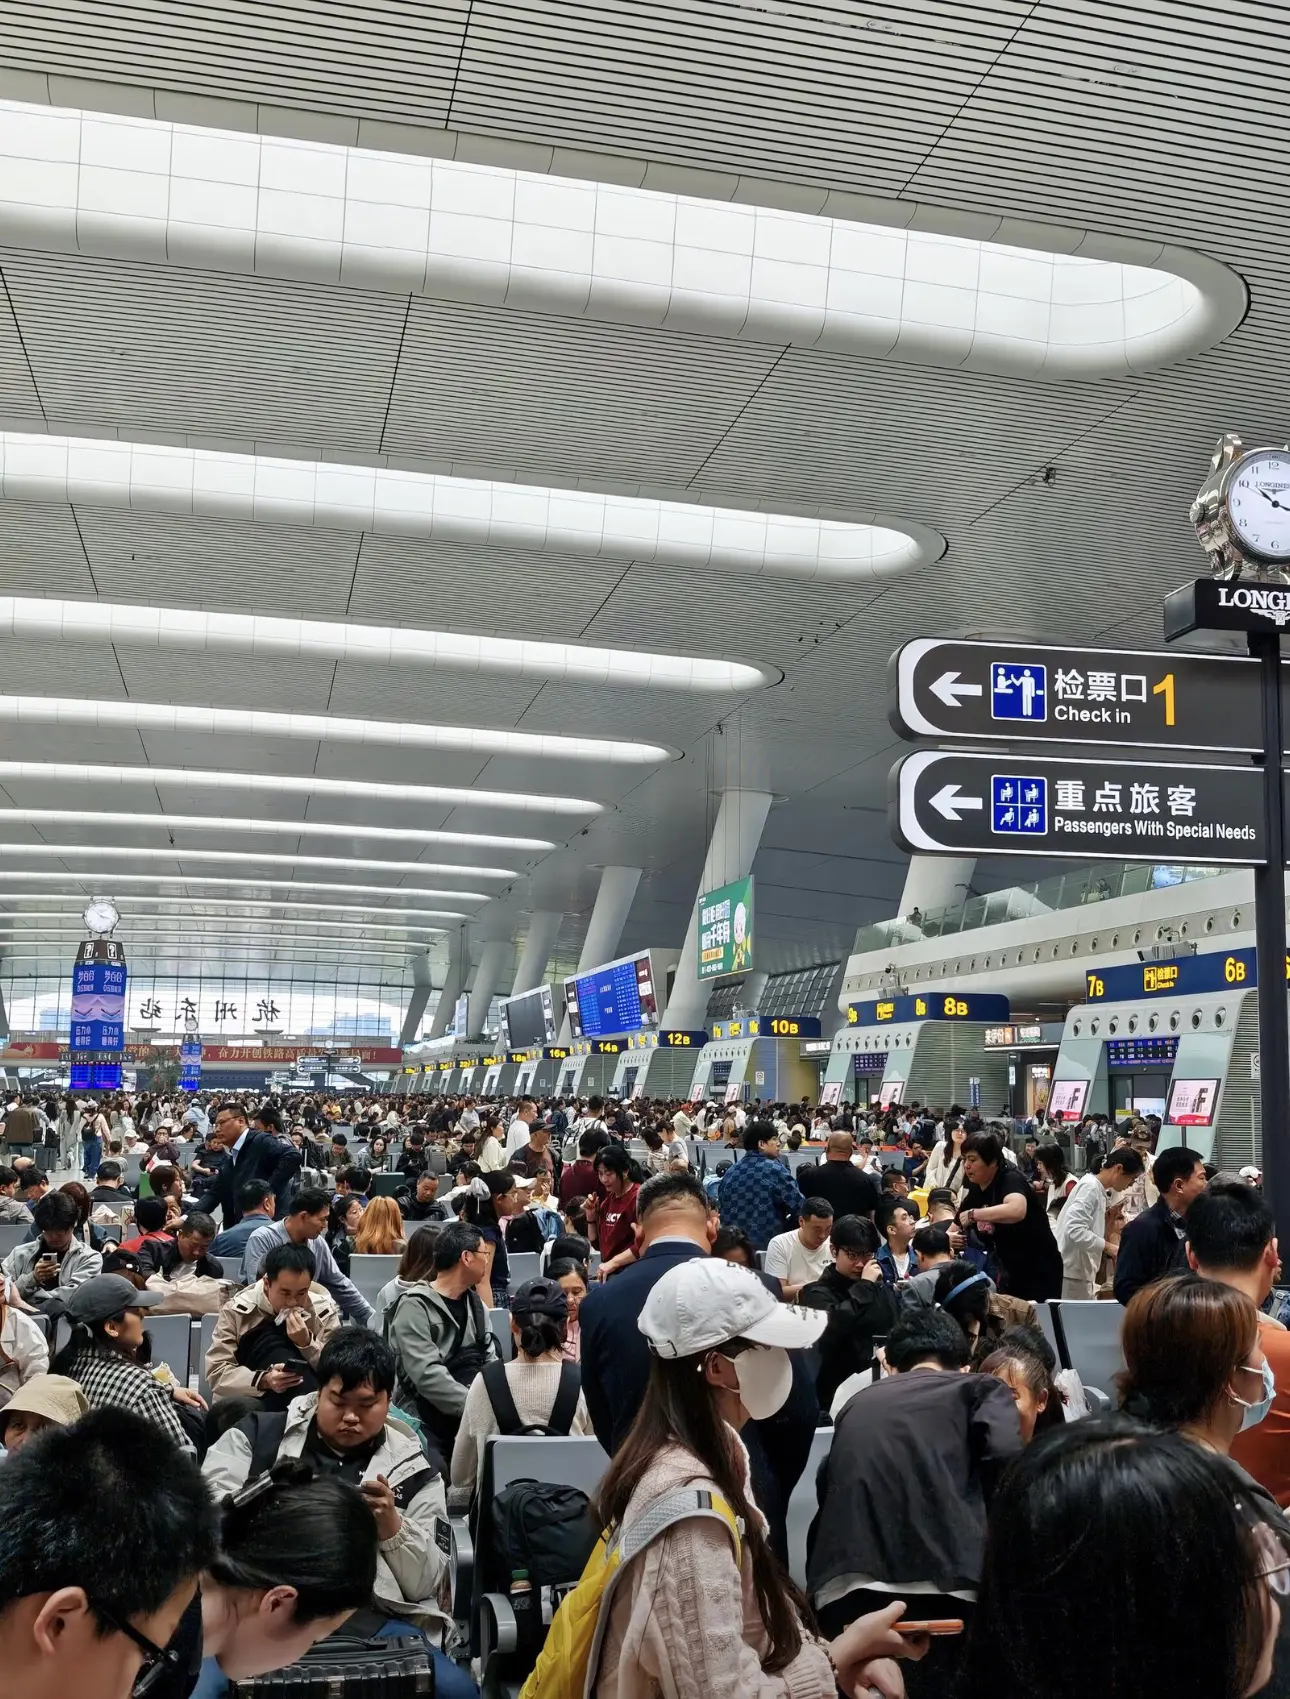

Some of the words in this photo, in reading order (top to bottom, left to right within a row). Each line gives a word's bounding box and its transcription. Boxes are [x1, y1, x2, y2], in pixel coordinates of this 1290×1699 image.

[1251, 466, 1259, 474] 11
[1268, 461, 1279, 470] 12
[1238, 479, 1249, 488] 10
[1233, 498, 1241, 508] 9
[1239, 518, 1247, 527] 8
[1252, 534, 1260, 542] 7
[1270, 540, 1280, 549] 6
[1054, 668, 1147, 703] 检票口
[1152, 674, 1175, 726] 1
[1054, 705, 1112, 723] Check
[1115, 708, 1131, 724] in
[1054, 780, 1196, 817] 重点旅客
[1054, 816, 1132, 837] Passengers
[1134, 819, 1164, 836] With
[1166, 821, 1214, 839] Special
[1216, 823, 1256, 840] Needs
[1225, 956, 1246, 983] 6B
[1087, 975, 1105, 997] 7B
[943, 997, 968, 1016] 8B
[770, 1019, 799, 1034] 10B
[667, 1032, 691, 1045] 12B
[549, 1048, 566, 1059] 16B
[599, 1042, 618, 1053] 14B
